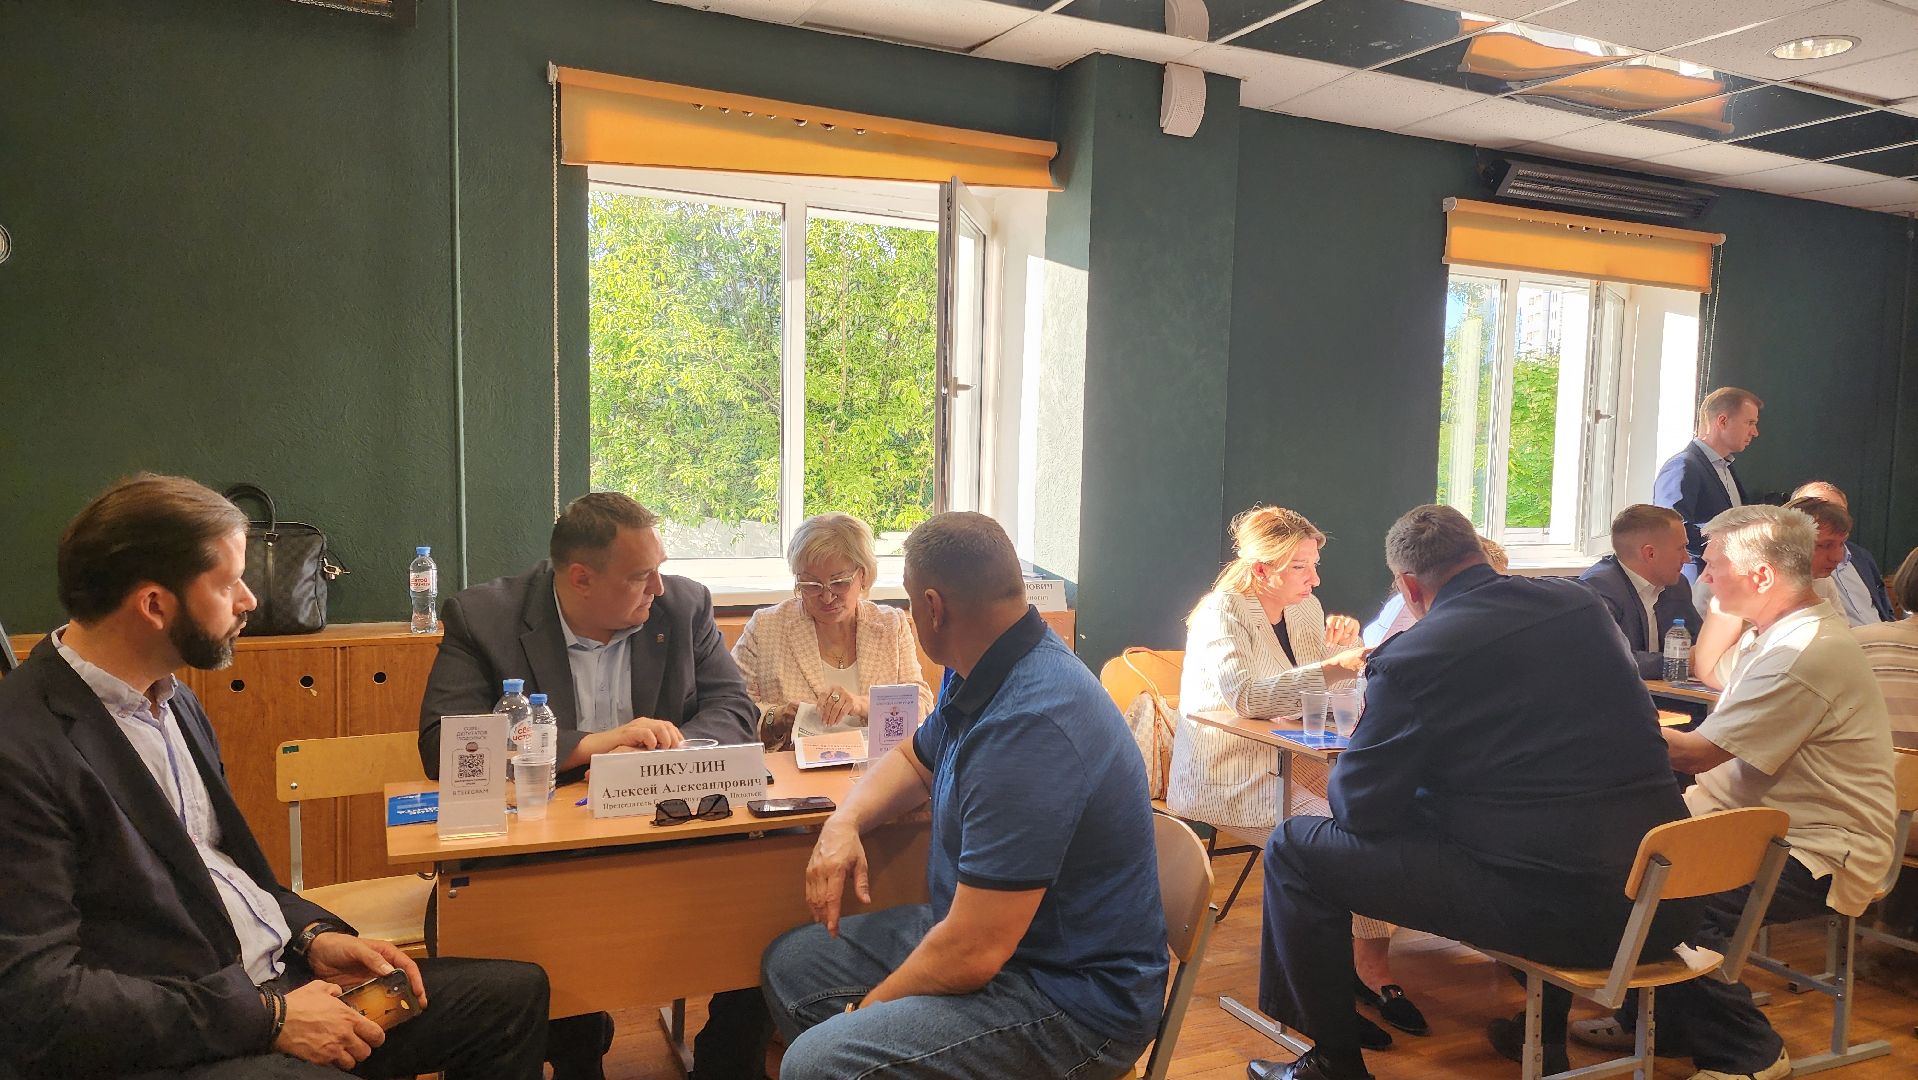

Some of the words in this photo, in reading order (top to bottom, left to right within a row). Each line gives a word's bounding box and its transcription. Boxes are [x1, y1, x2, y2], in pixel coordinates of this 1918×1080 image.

[640, 759, 726, 778] НИКУЛИН
[602, 783, 658, 799] Алексей
[662, 778, 762, 793] Александрович
[603, 800, 652, 810] Председатель
